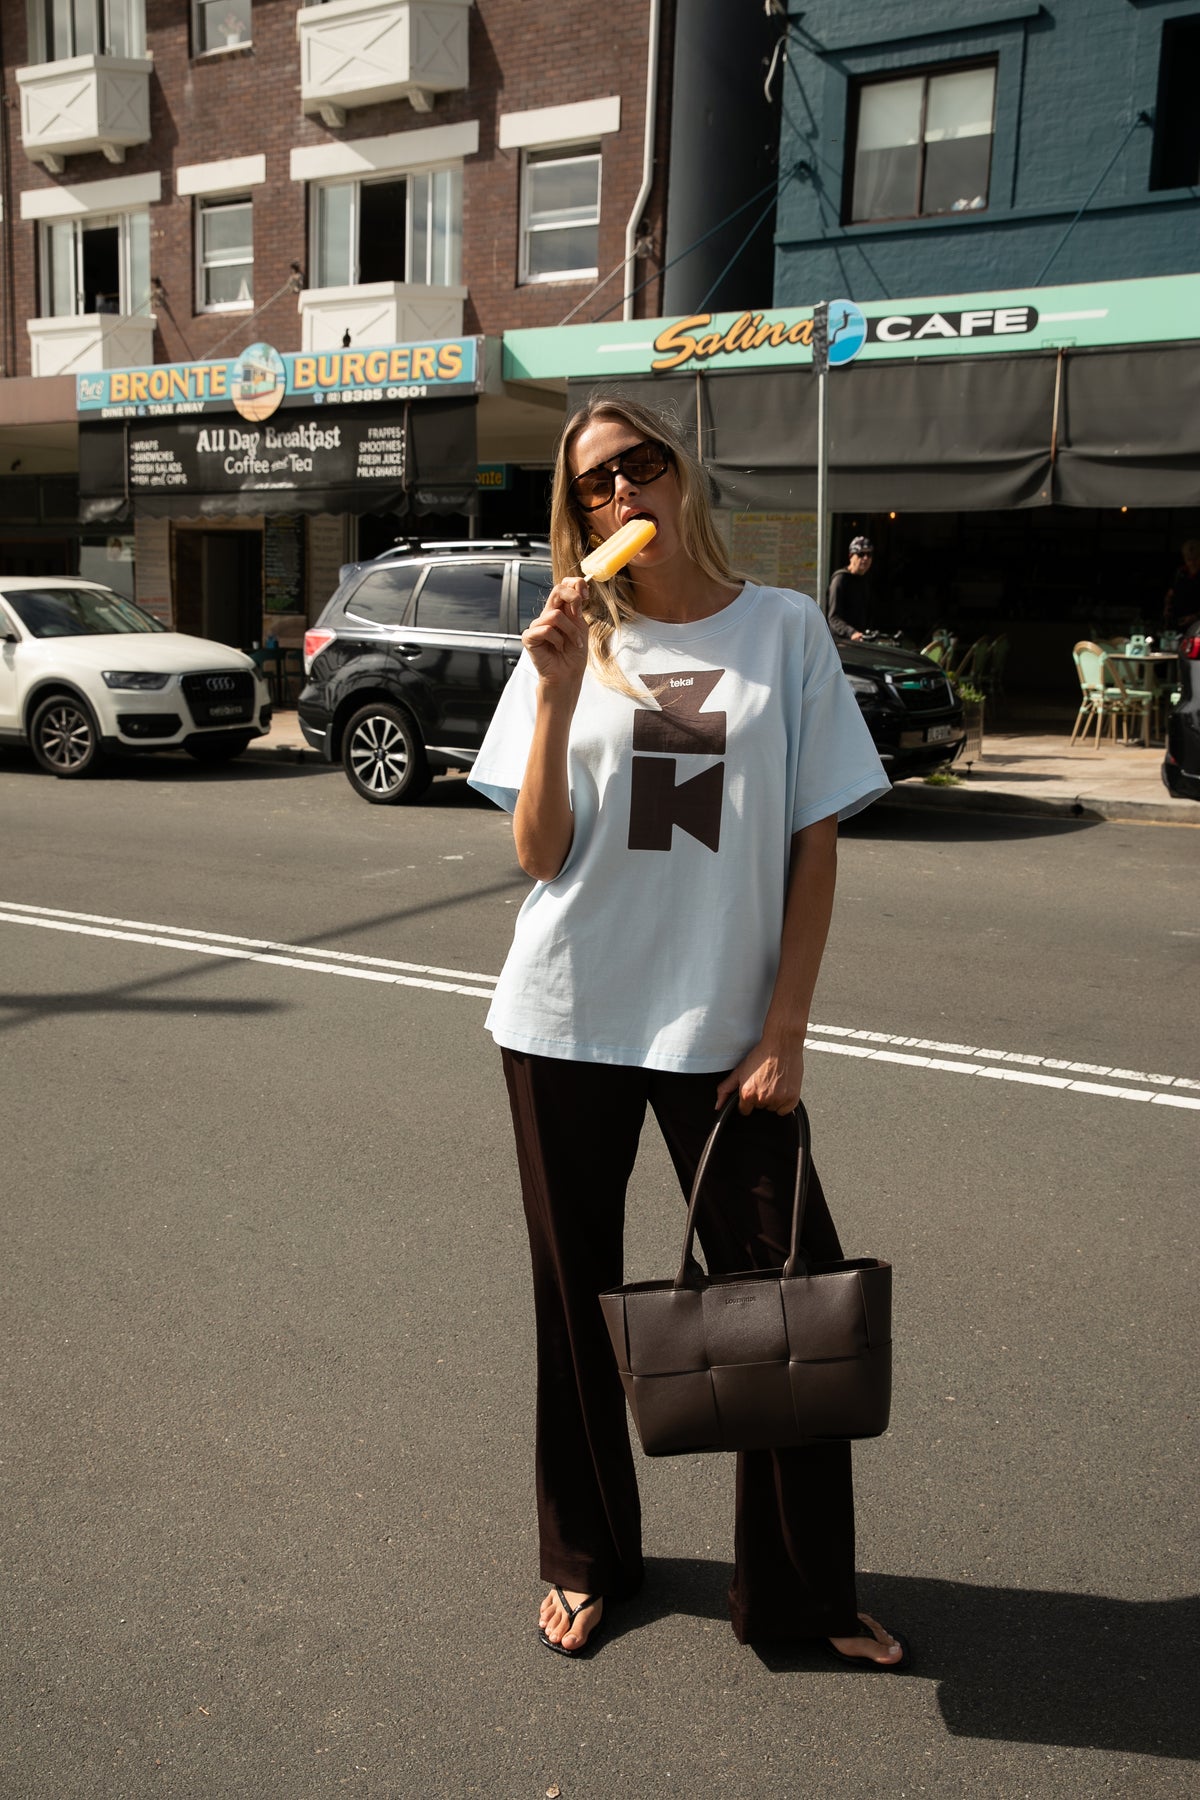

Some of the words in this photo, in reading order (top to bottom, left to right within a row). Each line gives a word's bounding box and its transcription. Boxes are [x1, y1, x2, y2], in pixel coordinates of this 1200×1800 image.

[651, 310, 816, 371] Salina
[876, 307, 1029, 342] CAFE
[110, 365, 228, 402] BRONTE
[293, 344, 463, 389] BURGERS
[148, 403, 174, 415] TAKE
[175, 402, 205, 414] AWAY
[196, 429, 226, 453] All
[228, 429, 260, 456] Day
[265, 421, 341, 452] Breakfast
[359, 440, 401, 453] SMOOTHIES
[224, 455, 270, 474] Coffee
[288, 453, 313, 472] Tea
